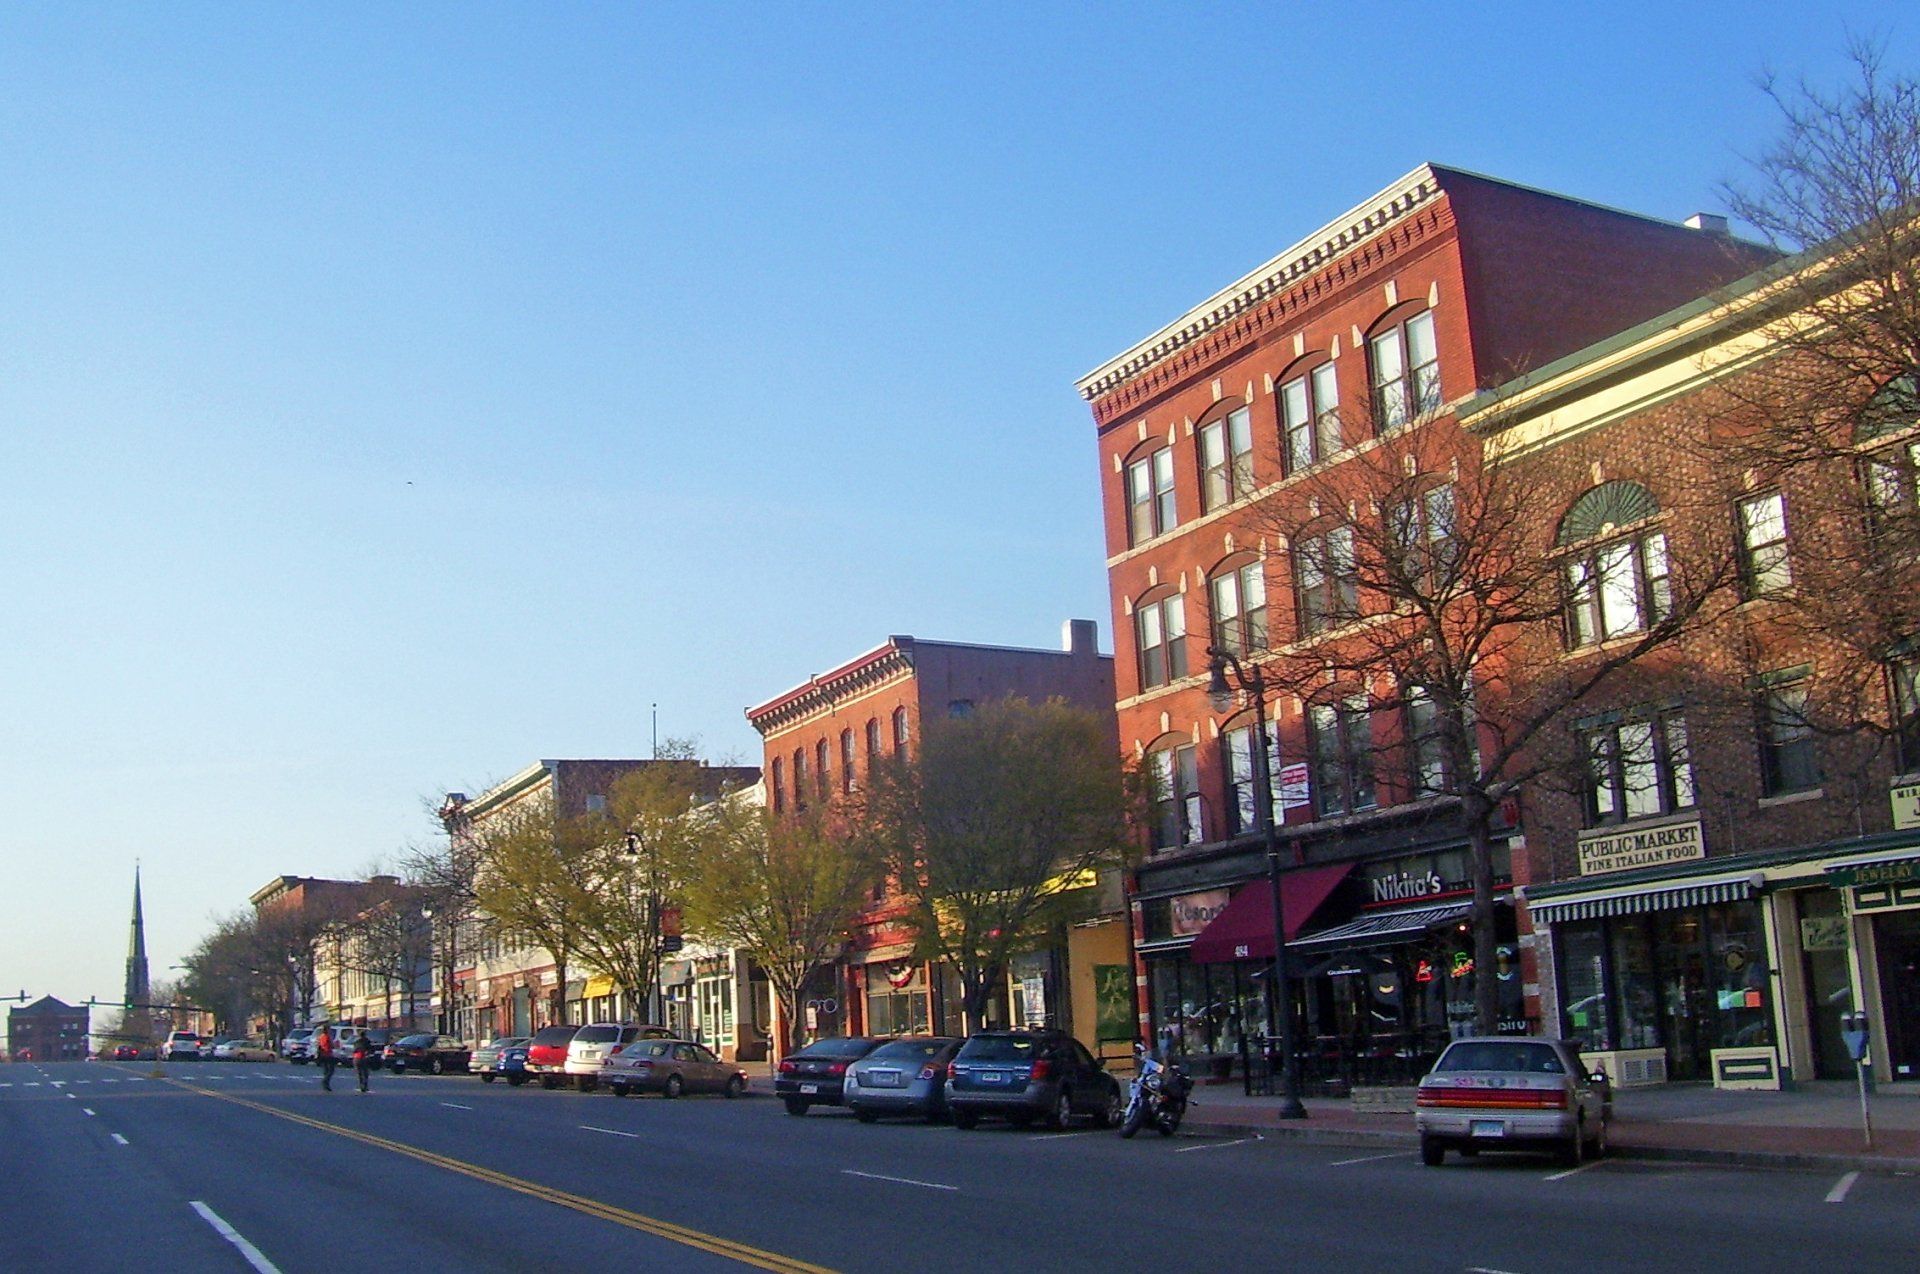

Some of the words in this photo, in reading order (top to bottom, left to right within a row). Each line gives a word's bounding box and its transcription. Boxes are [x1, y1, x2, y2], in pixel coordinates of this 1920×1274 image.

[1897, 788, 1920, 798] MIR
[1582, 836, 1632, 859] PUBLIC
[1635, 826, 1698, 851] MARKET
[1586, 858, 1612, 872] FINE
[1616, 850, 1663, 868] ITALIAN
[1667, 845, 1697, 860] FOOD
[1373, 871, 1441, 901] Nikita's
[1856, 865, 1912, 882] JEWELRY
